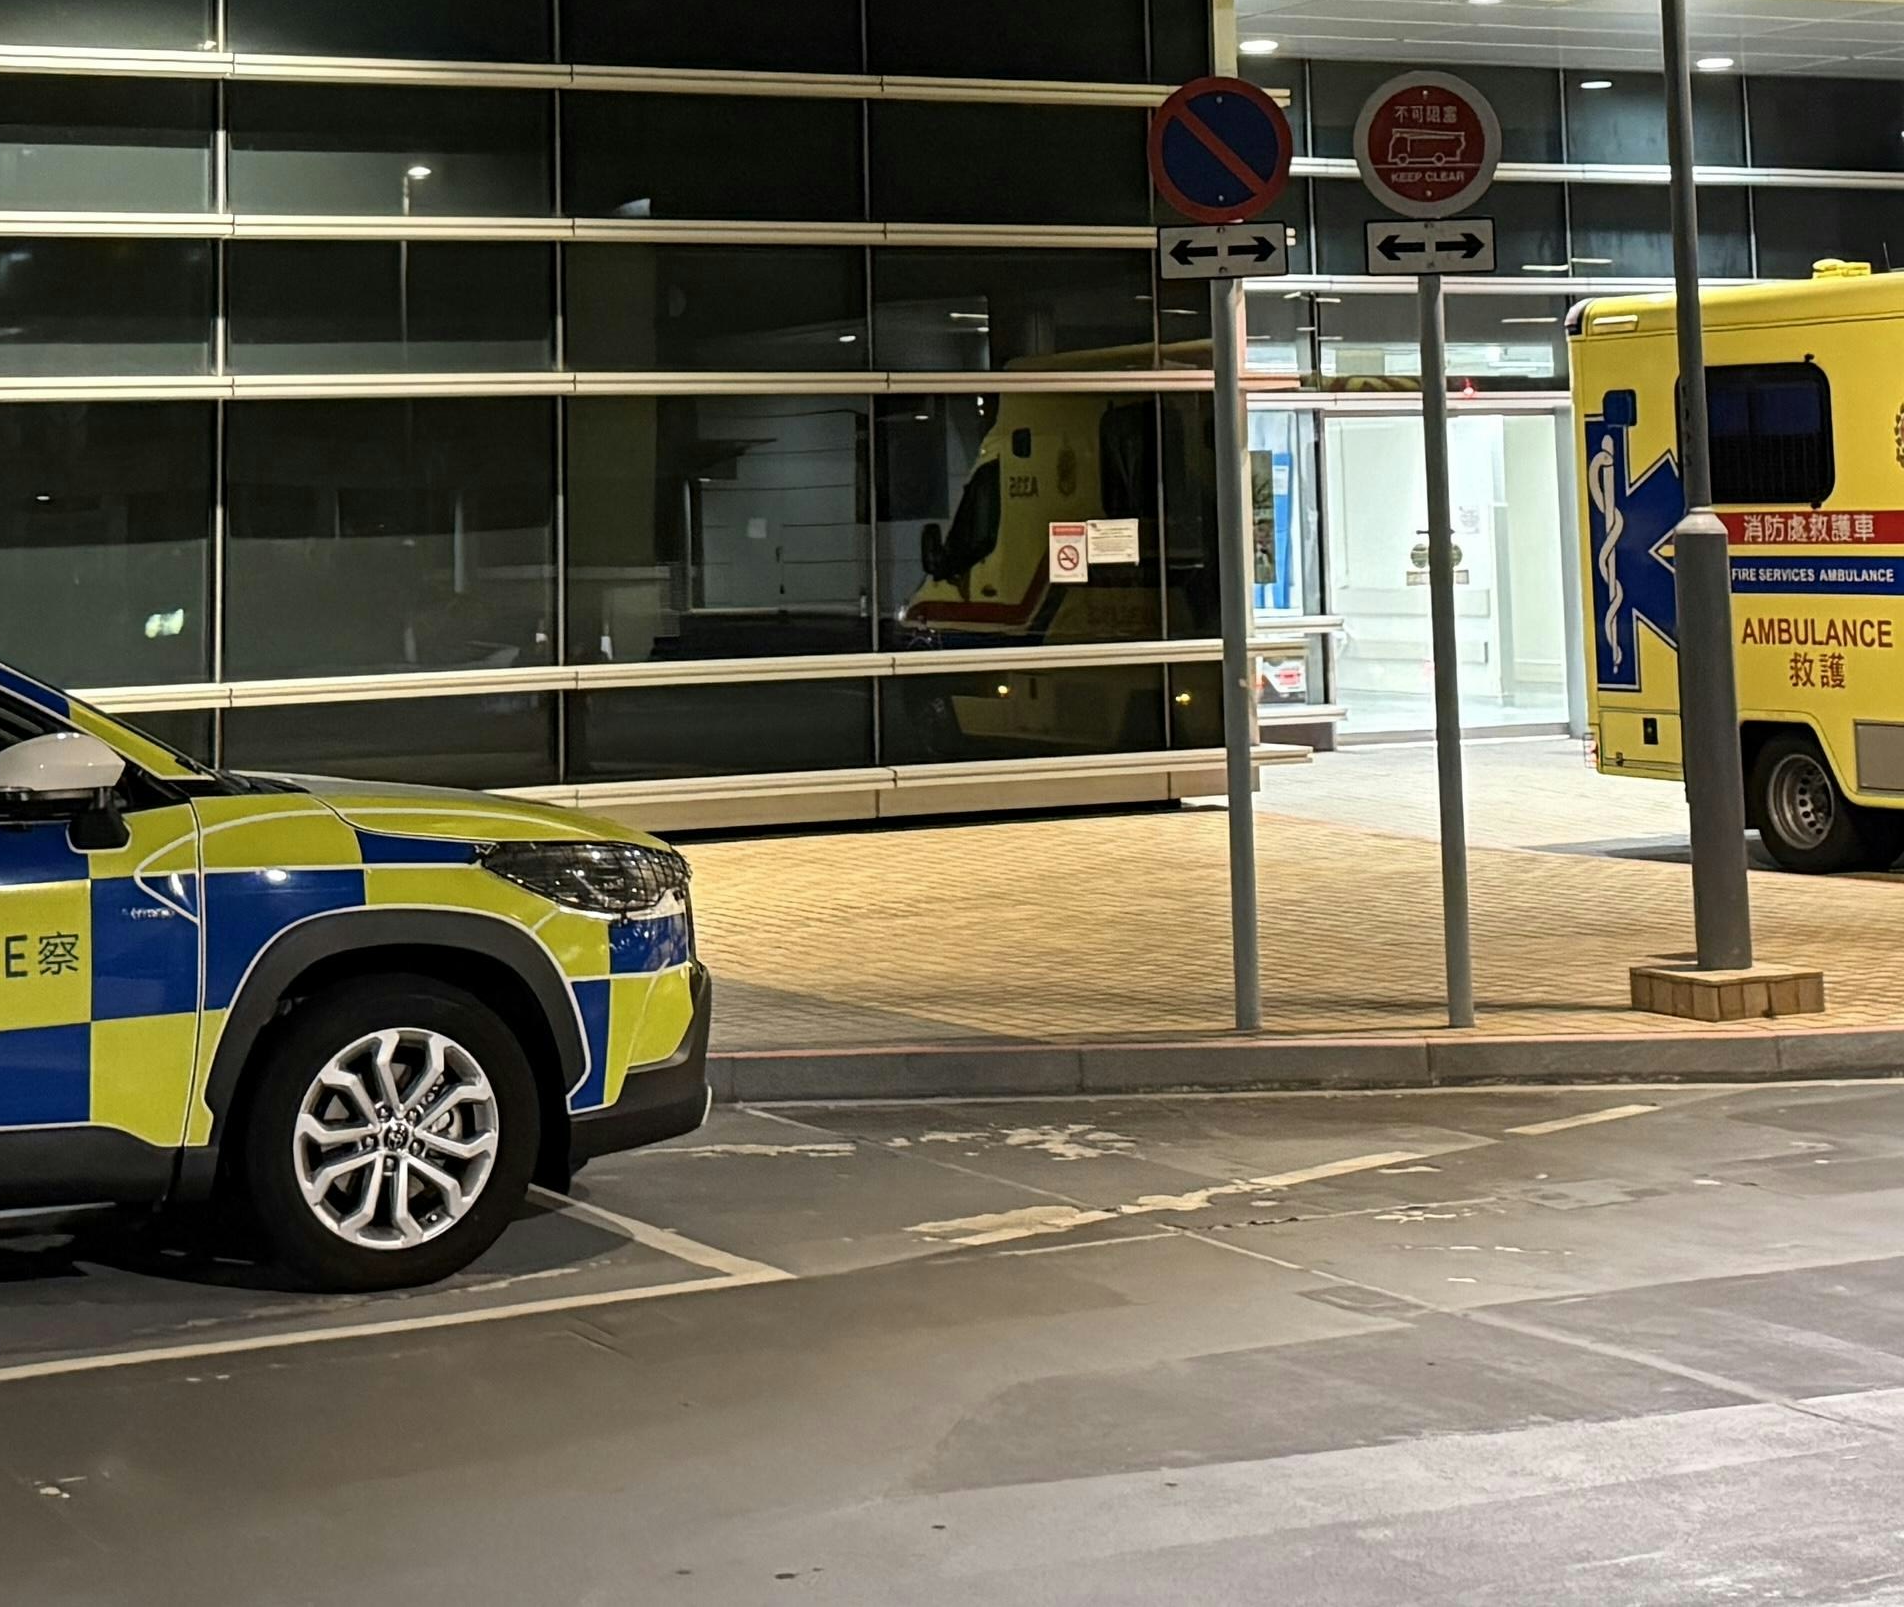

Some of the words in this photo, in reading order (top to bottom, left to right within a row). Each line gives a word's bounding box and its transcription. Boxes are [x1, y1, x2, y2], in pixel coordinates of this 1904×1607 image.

[1391, 171, 1423, 183] KEEP
[1425, 171, 1465, 182] CLEAR
[1744, 514, 1875, 542] 消防處救護車
[1732, 568, 1756, 581] FIRE
[1758, 568, 1815, 582] SERVICES
[1819, 569, 1894, 582] AMBULANCE
[1741, 617, 1893, 648] AMBULANCE
[1789, 652, 1846, 689] 救護
[38, 931, 80, 976] 察
